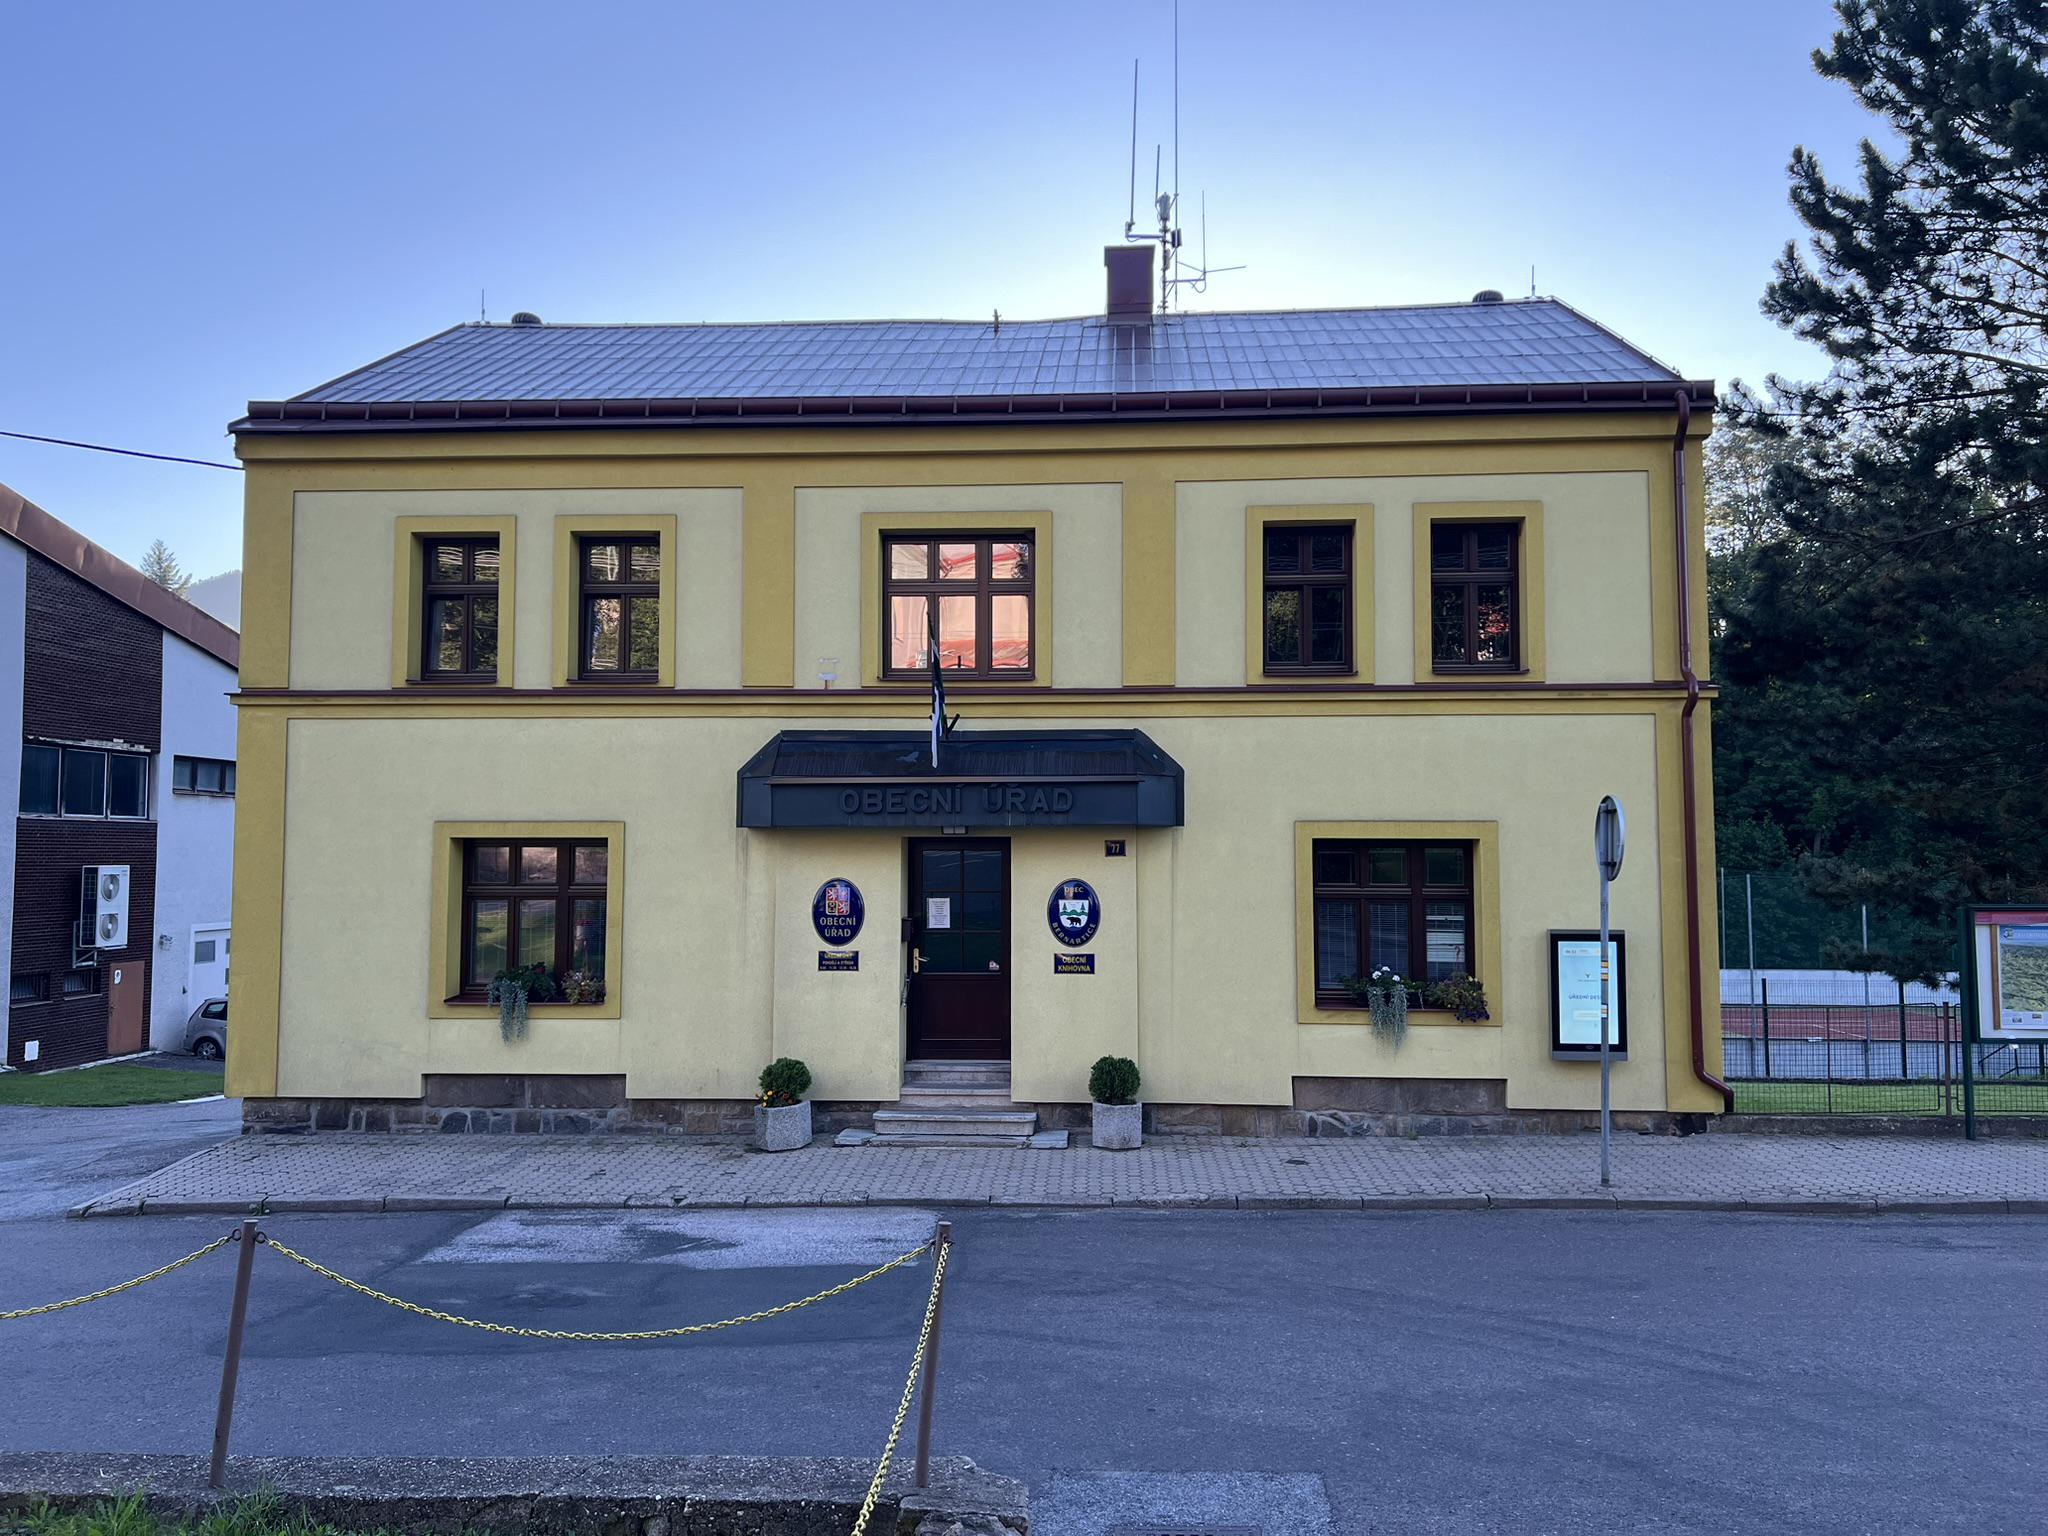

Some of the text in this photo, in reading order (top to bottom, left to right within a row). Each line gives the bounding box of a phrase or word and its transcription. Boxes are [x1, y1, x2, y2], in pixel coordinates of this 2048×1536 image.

[839, 782, 1074, 815] OBECNÍ ÚŘAD
[820, 915, 856, 925] OBECNÍ
[825, 926, 851, 937] ÚŘAD
[1053, 922, 1096, 945] BERNARTICE
[1058, 964, 1091, 972] KNIHOVNA
